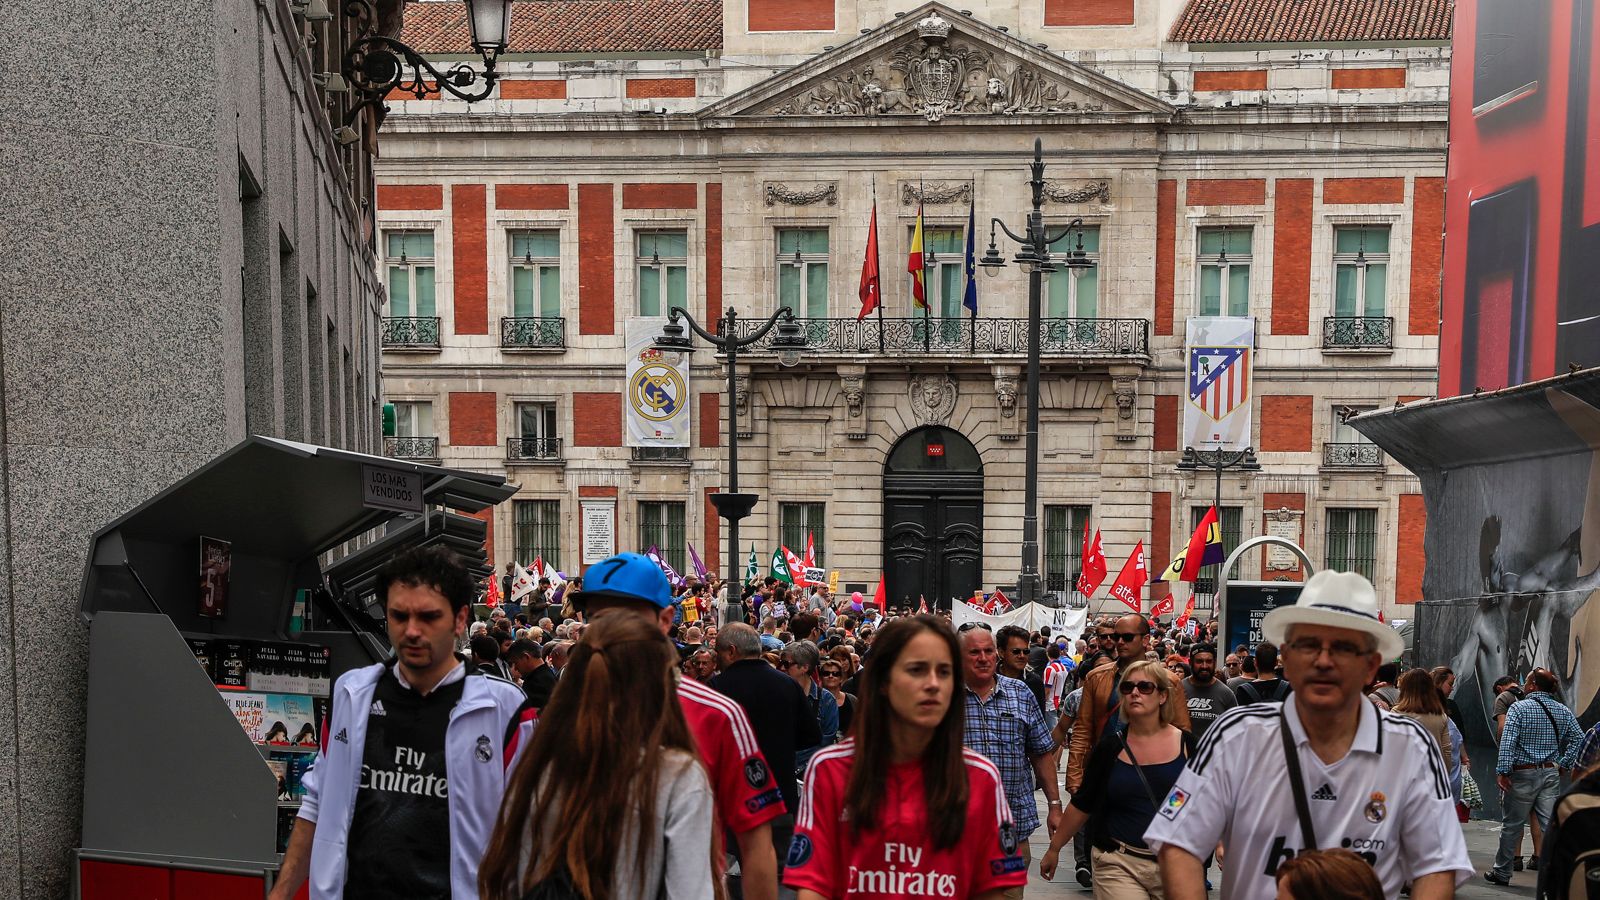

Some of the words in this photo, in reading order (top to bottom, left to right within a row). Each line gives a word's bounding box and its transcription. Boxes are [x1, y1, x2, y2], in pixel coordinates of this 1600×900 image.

[372, 471, 387, 484] LOS
[389, 474, 407, 488] MAS
[370, 484, 413, 502] VENDIDOS
[603, 558, 628, 584] 7
[1053, 610, 1067, 625] NO
[223, 660, 243, 668] CHICA
[225, 677, 241, 685] TREN
[394, 746, 426, 770] Fly
[359, 765, 448, 798] Emirate
[885, 842, 922, 867] Fly
[847, 865, 956, 897] Emirates
